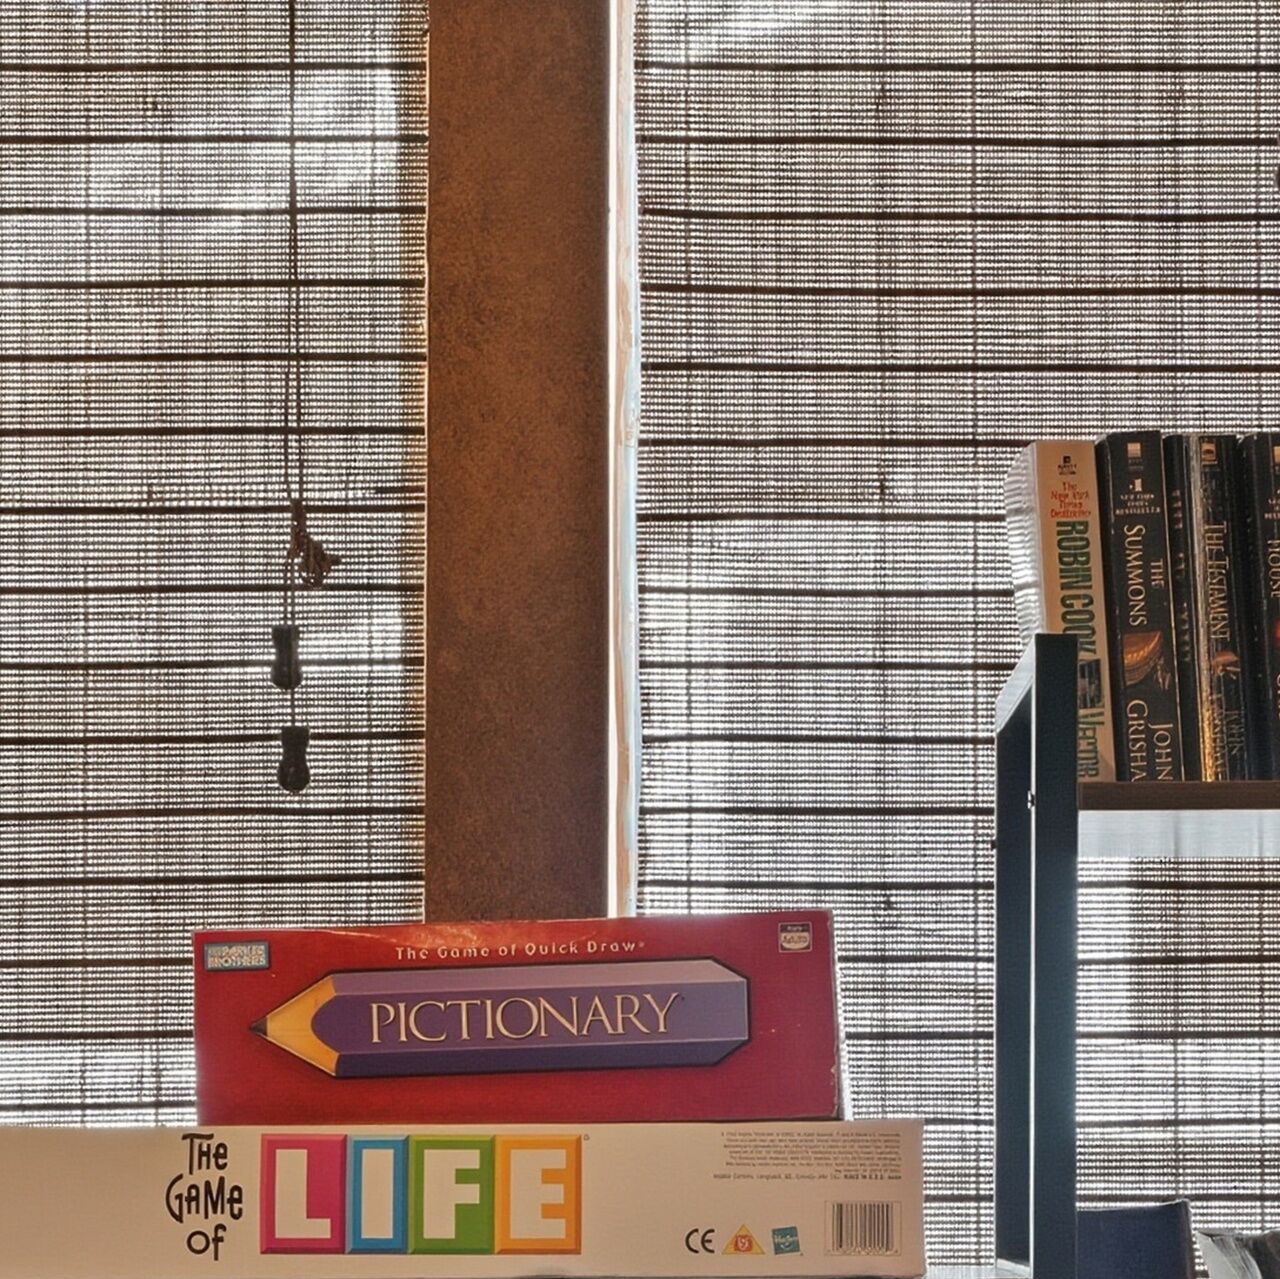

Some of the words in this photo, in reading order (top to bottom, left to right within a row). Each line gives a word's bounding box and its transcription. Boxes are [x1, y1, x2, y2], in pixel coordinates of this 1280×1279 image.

[1056, 520, 1094, 591] ROBIN
[1204, 522, 1227, 551] THE
[1123, 524, 1147, 627] SUMMONS
[1150, 558, 1165, 589] THE
[1207, 557, 1231, 642] TESTAMENT
[1061, 593, 1097, 656] COOK
[1126, 699, 1149, 781] GRISHA
[1151, 723, 1174, 781] JOHN
[396, 947, 428, 960] The
[438, 945, 490, 959] Game
[497, 943, 517, 957] of
[524, 940, 578, 957] Quick
[369, 992, 683, 1044] PICTIONARY
[273, 1147, 568, 1240] LIFE
[685, 1228, 715, 1254] CE
